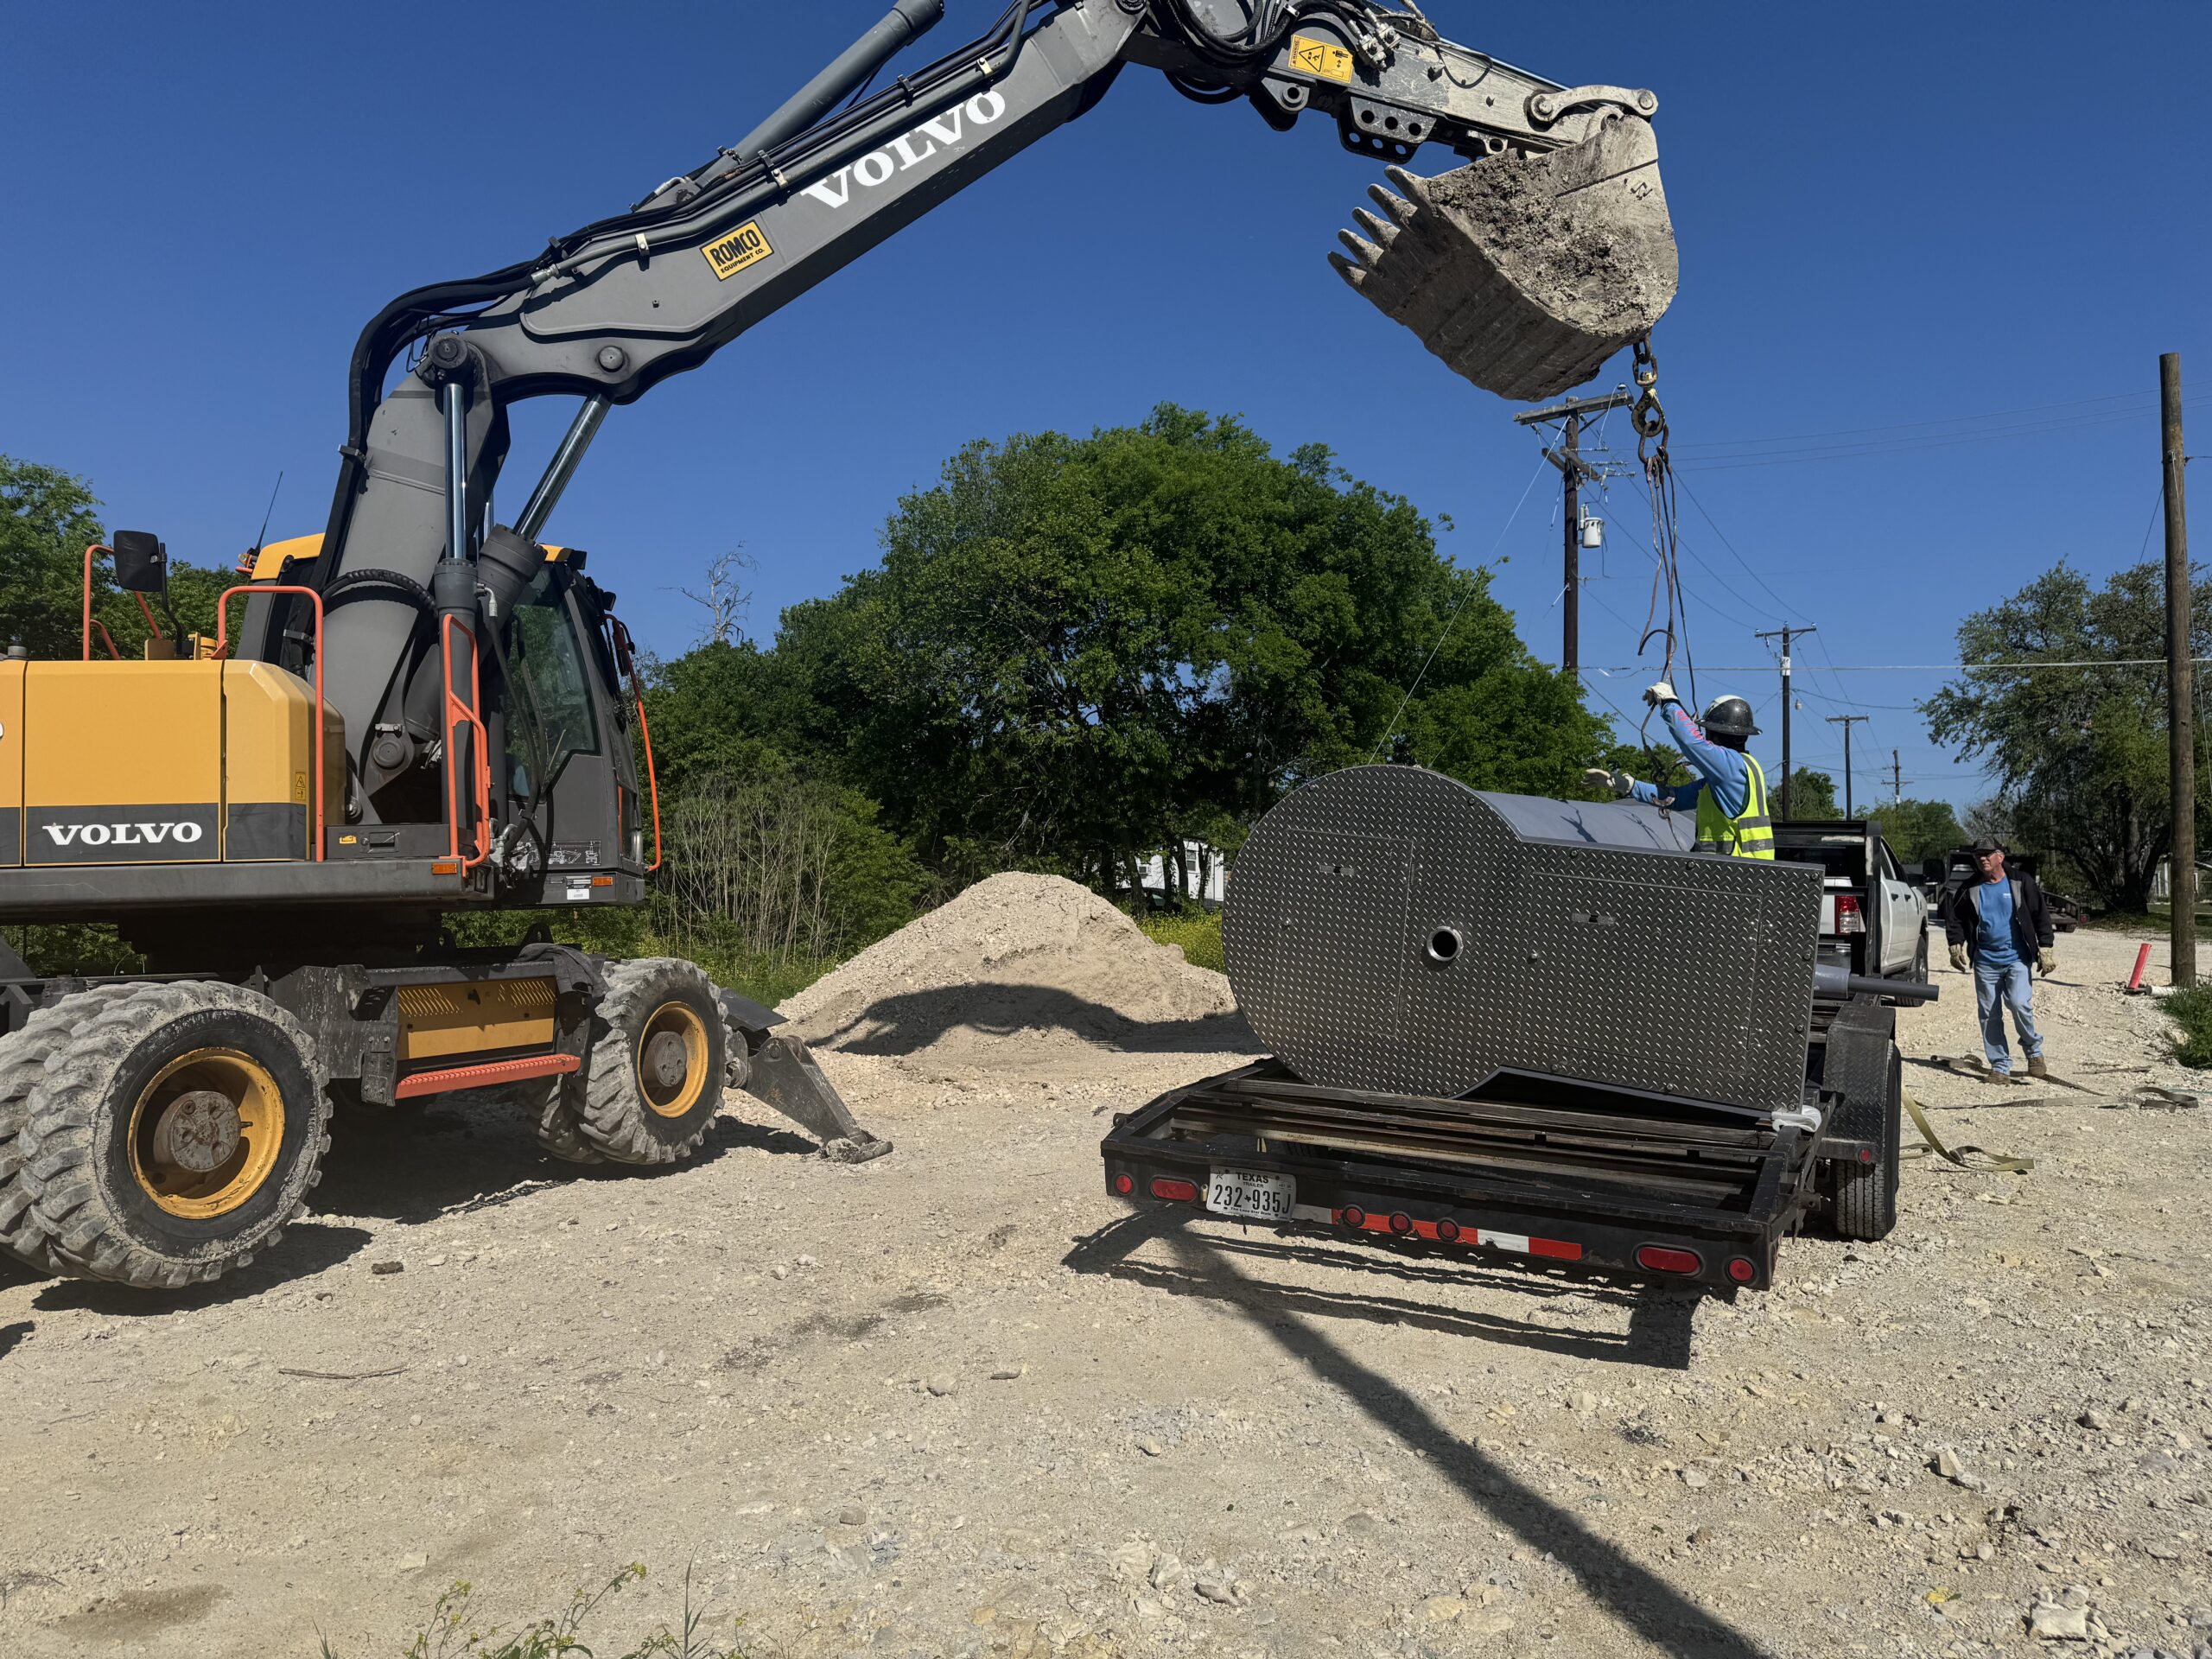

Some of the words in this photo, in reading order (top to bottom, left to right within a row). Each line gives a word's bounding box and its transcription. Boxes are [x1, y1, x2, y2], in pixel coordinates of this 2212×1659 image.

[799, 90, 1006, 209] VOLVO
[709, 229, 761, 267] ROMCO
[720, 252, 754, 273] EQUIPMENT
[41, 822, 202, 846] VOLVO
[1236, 1172, 1269, 1184] TEXAS
